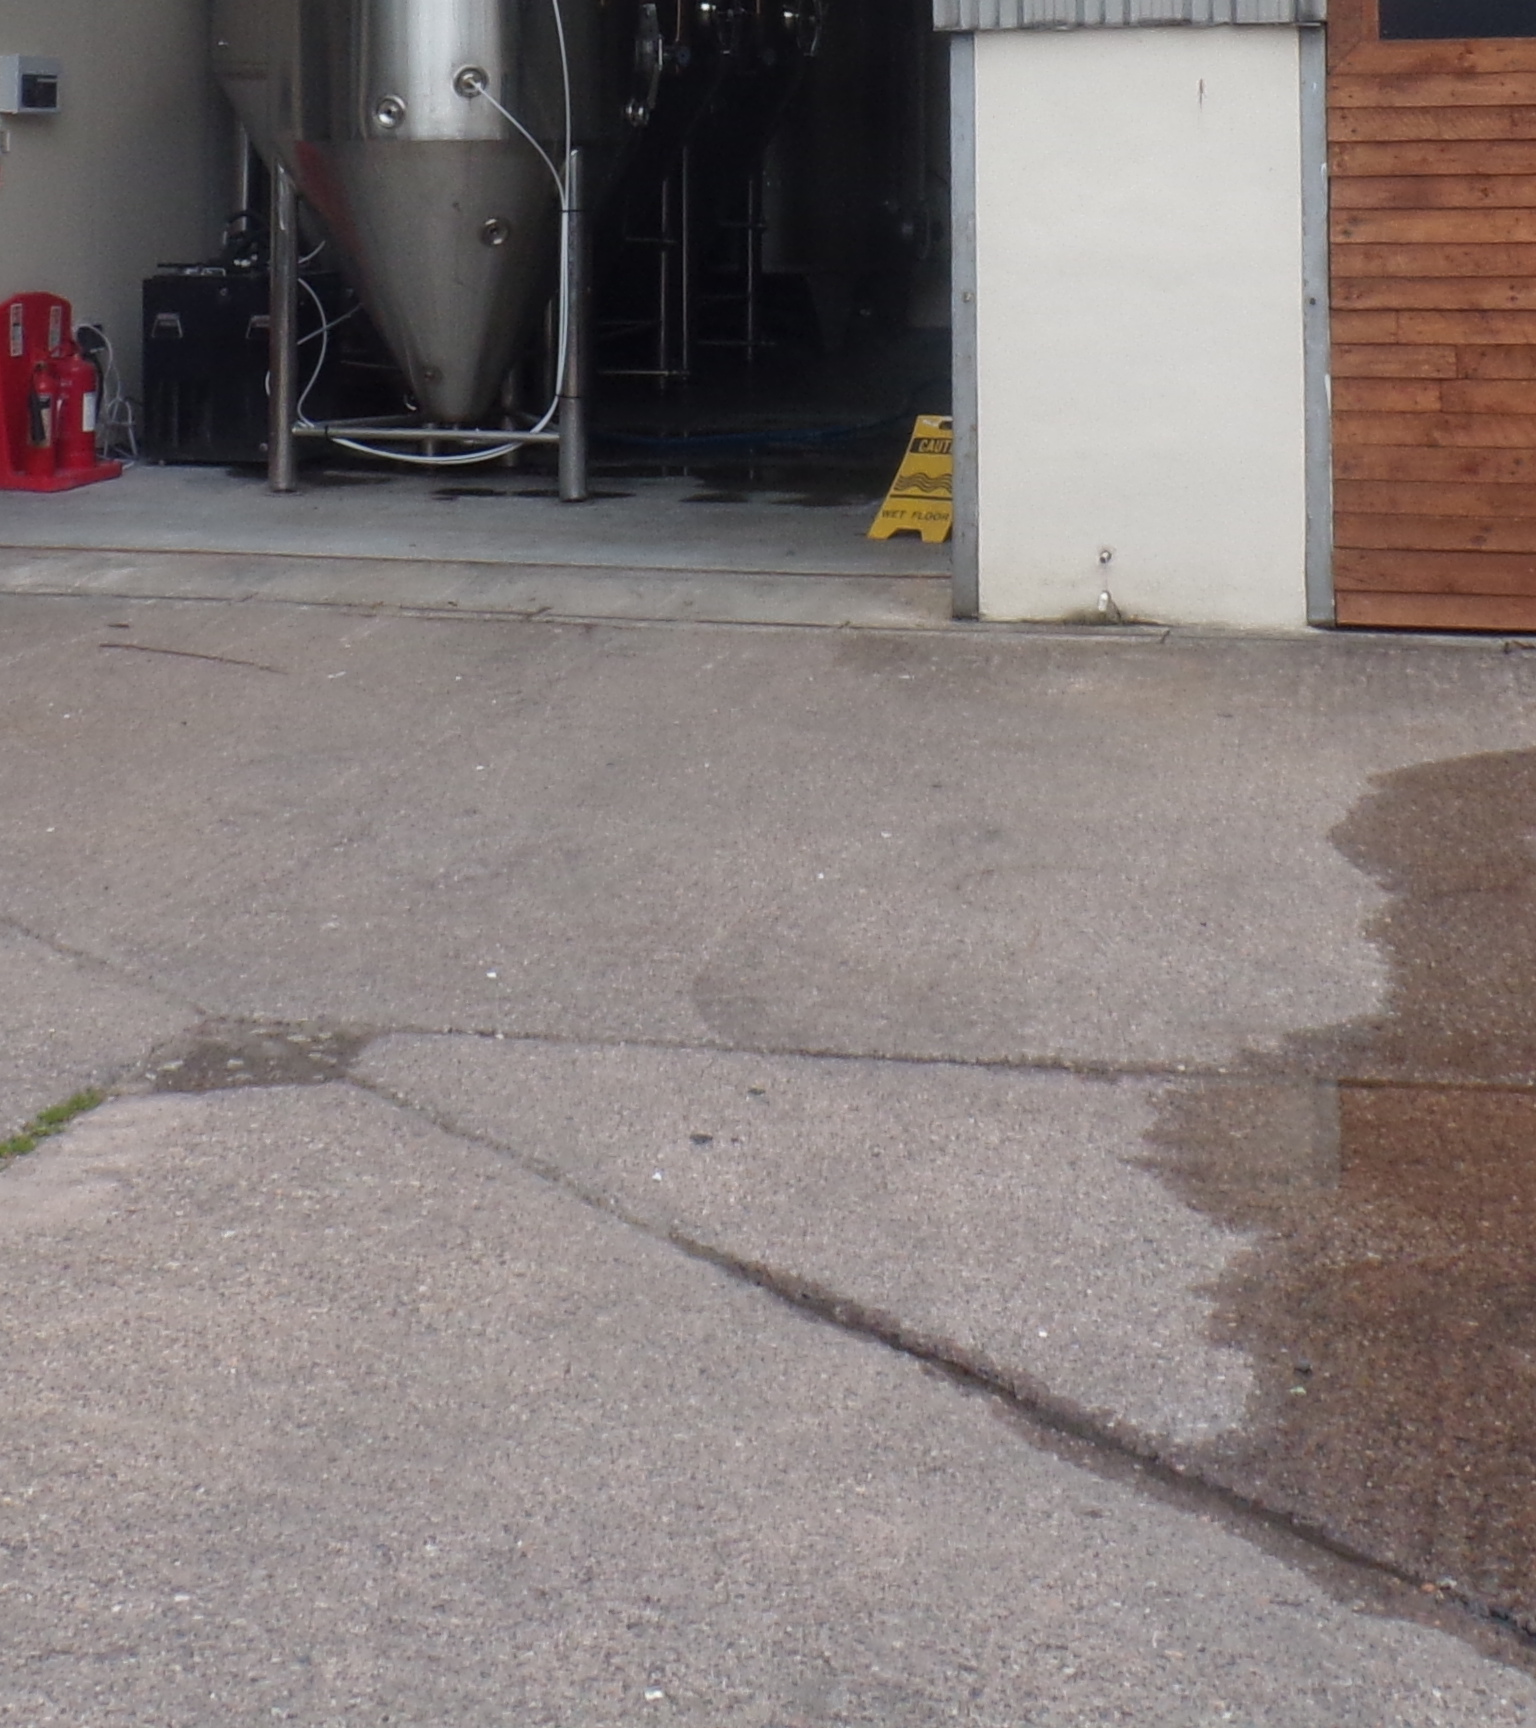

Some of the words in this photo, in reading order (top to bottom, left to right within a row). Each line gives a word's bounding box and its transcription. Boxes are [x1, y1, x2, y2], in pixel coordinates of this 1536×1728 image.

[919, 438, 953, 453] CAUT
[882, 509, 907, 520] WET
[911, 510, 951, 522] FLOOR
